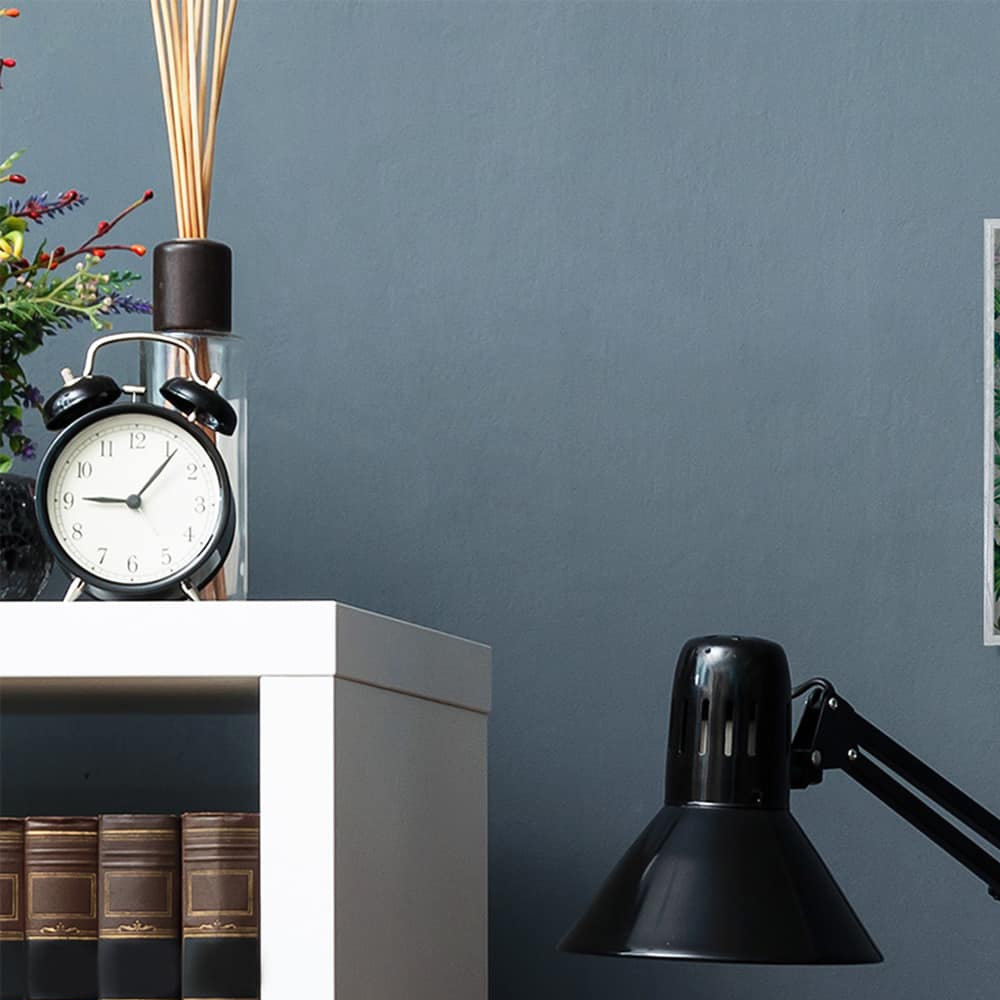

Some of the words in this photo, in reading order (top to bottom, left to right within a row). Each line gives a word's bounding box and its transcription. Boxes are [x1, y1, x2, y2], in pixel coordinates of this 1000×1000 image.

[99, 440, 113, 457] 11
[129, 432, 146, 450] 12
[77, 462, 92, 478] 10
[187, 464, 198, 480] 2
[63, 492, 74, 509] 9
[195, 497, 206, 513] 3
[72, 523, 83, 540] 8
[183, 526, 193, 542] 4
[98, 548, 108, 565] 7
[127, 556, 138, 572] 6
[161, 548, 172, 564] 5
